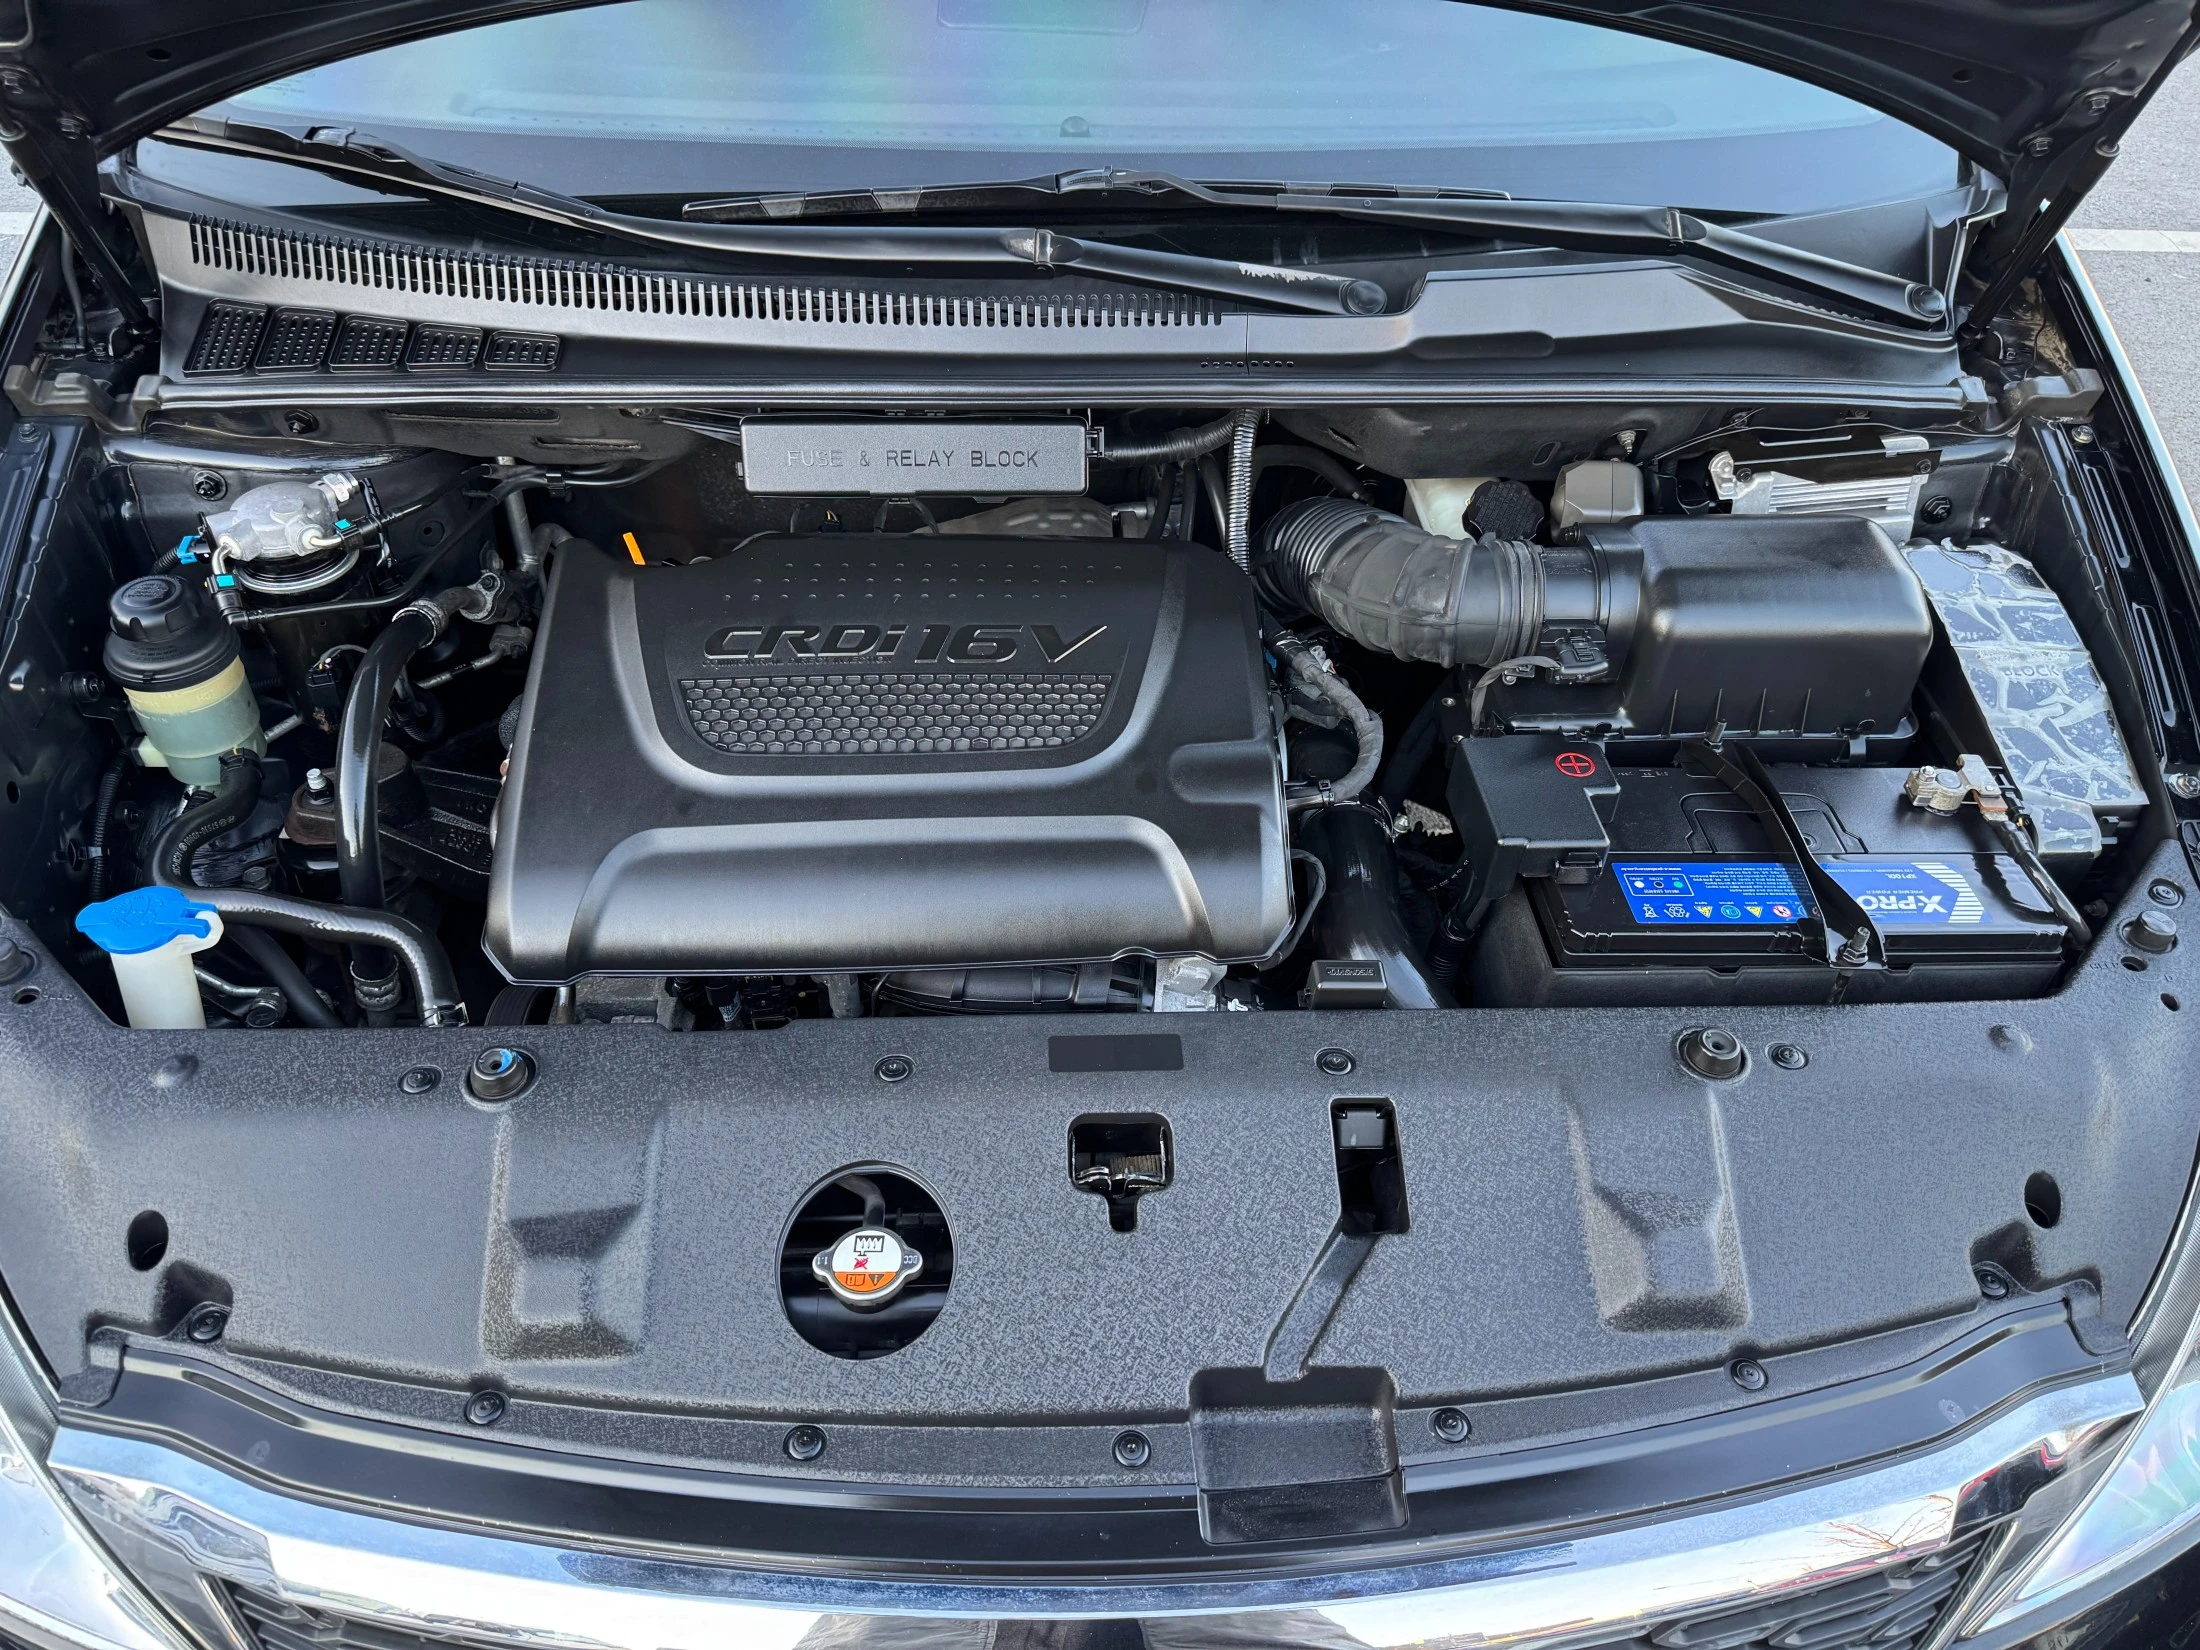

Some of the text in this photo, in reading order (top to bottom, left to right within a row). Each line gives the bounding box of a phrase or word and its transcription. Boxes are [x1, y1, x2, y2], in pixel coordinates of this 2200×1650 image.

[787, 450, 1039, 468] FUSE & RELAY BLOCK
[704, 624, 1108, 663] CRDi 16V
[1855, 895, 1949, 914] X-PRO
